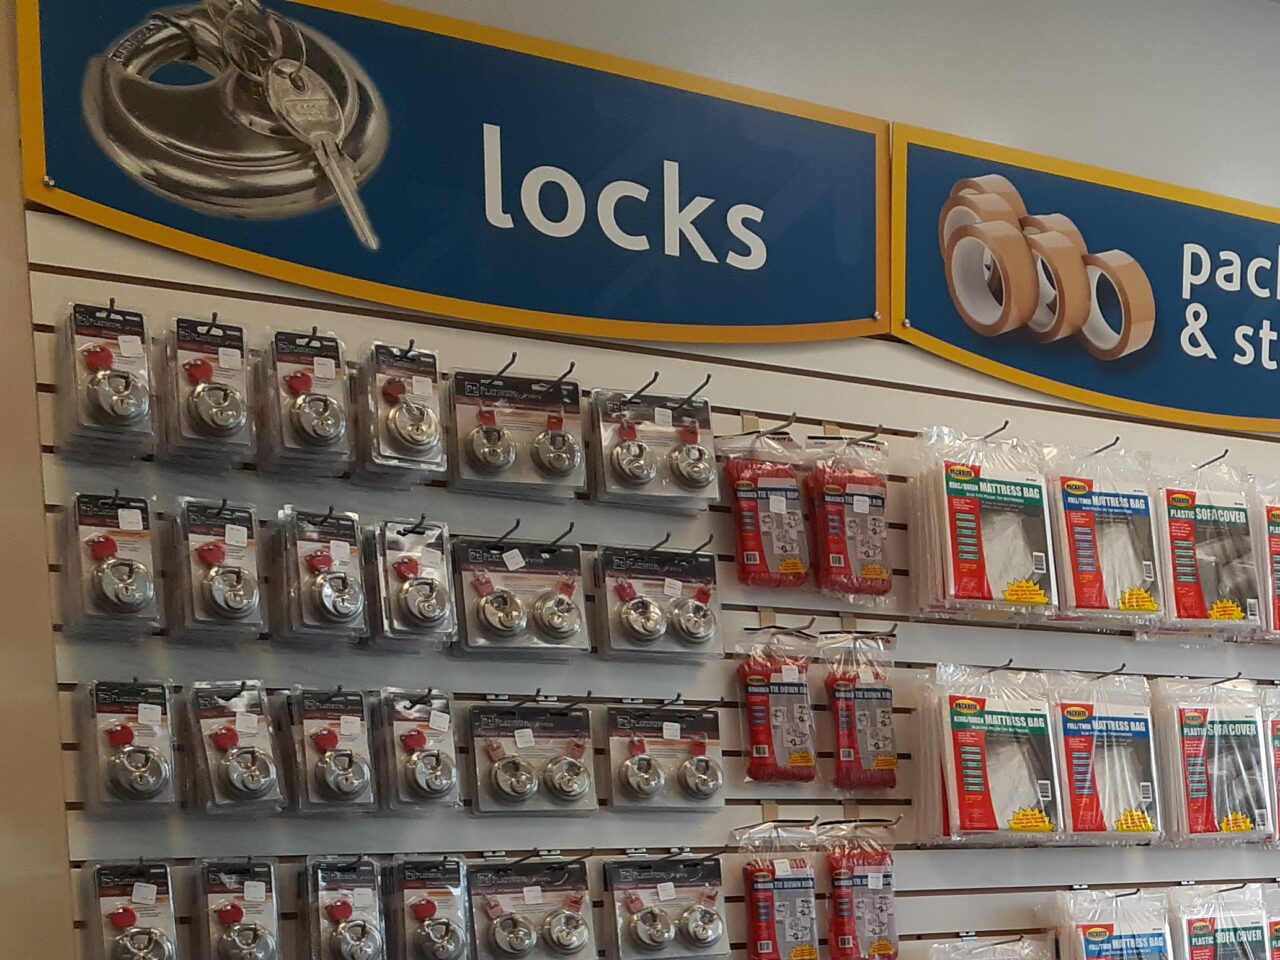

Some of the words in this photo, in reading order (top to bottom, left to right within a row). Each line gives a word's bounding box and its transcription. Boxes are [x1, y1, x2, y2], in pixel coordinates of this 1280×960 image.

[483, 122, 767, 270] locks
[1180, 302, 1217, 359] &
[979, 481, 1022, 497] MATTRESS
[1023, 486, 1040, 498] BAG
[1092, 495, 1129, 508] MATTRESS
[1130, 498, 1146, 509] BAG
[1170, 509, 1195, 520] PLASTIC
[1195, 508, 1218, 521] SOFA
[1218, 510, 1246, 523] COVER
[984, 714, 1027, 727] MATTRESS
[1027, 717, 1045, 728] BAG
[1092, 720, 1129, 730] MATTRESS
[1130, 721, 1146, 731] BAG
[1207, 724, 1229, 736] SOFA
[1229, 724, 1256, 736] COVER
[1149, 937, 1164, 947] BAG
[1192, 936, 1214, 946] PLASTIC
[1215, 931, 1236, 944] SOFA
